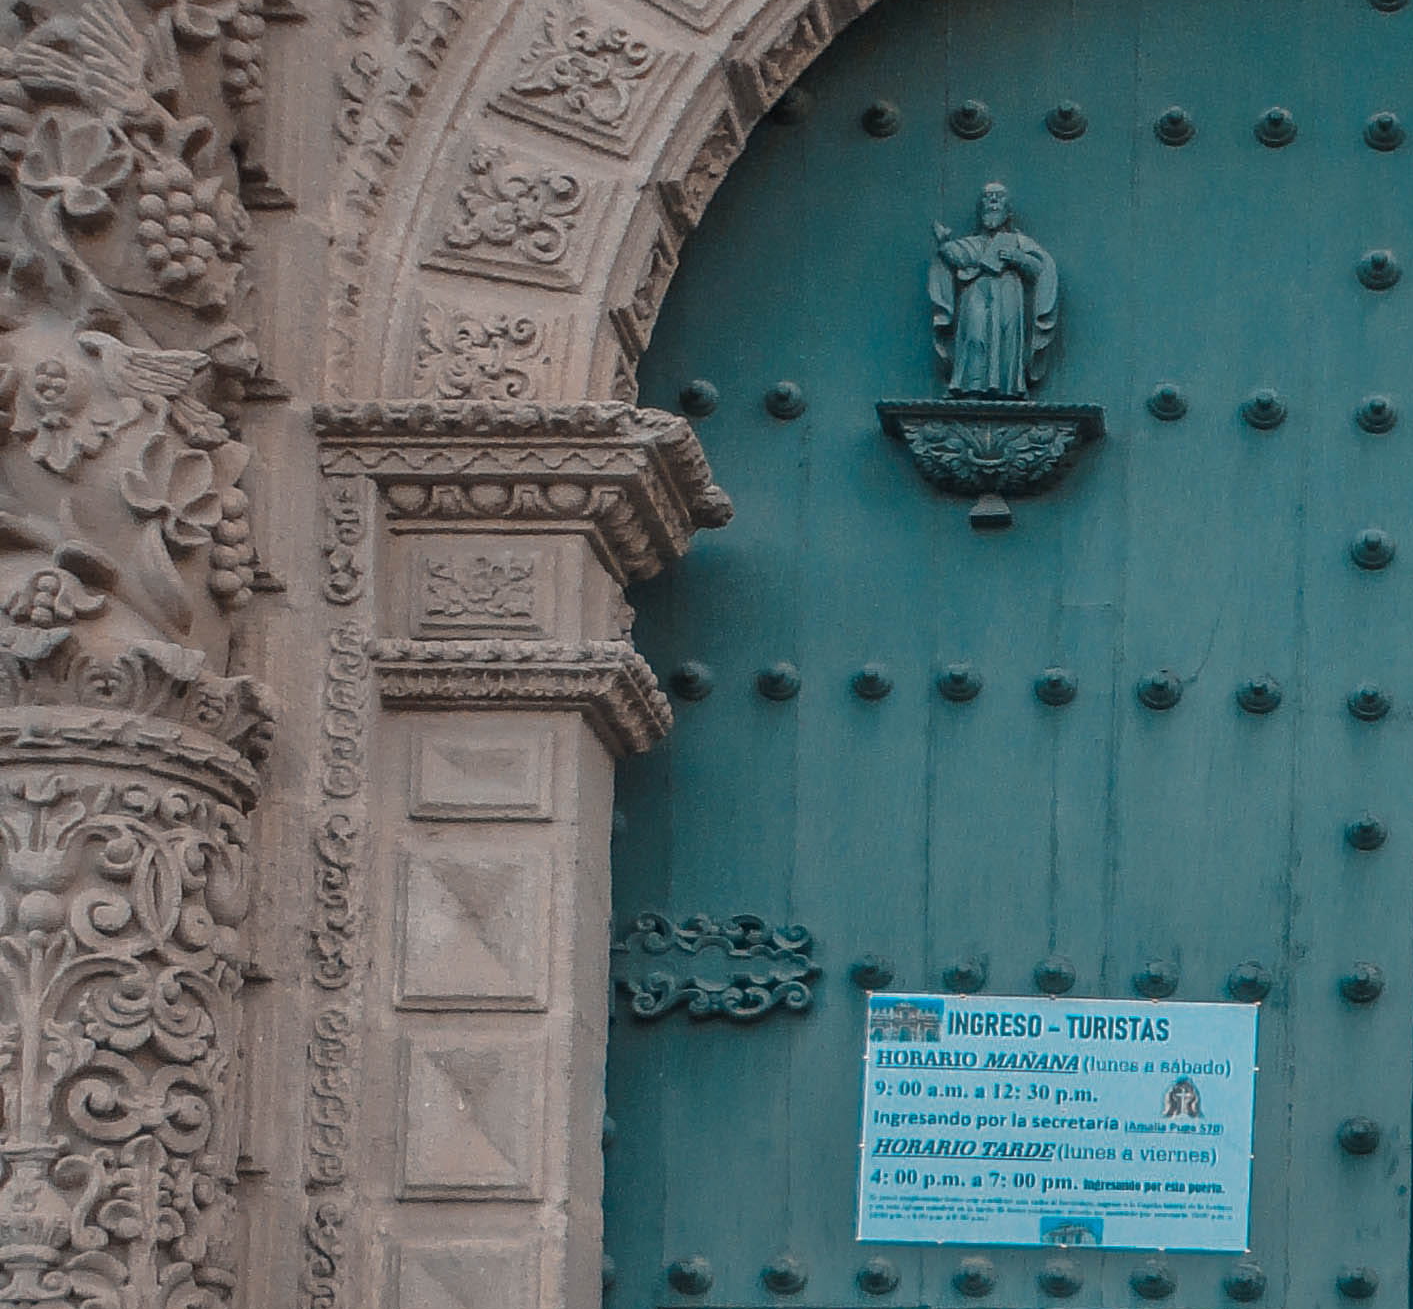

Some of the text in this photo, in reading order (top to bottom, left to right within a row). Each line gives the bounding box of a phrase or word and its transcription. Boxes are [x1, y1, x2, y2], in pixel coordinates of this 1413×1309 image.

[947, 1010, 1042, 1038] INGRESO
[1065, 1013, 1170, 1041] TURISTAS
[876, 1049, 1232, 1078] HORARIO MAÑANA (lunes a sábado)
[874, 1078, 1098, 1105] 9: 00 a.m. a 12: 30 p.m.
[873, 1109, 972, 1127] Ingresando
[975, 1115, 1007, 1130] por
[1011, 1111, 1027, 1128] la
[1031, 1115, 1119, 1131] secretaría
[872, 1138, 1218, 1166] HORARIO TARDE (lunes a viernes)
[870, 1168, 889, 1185] 4:
[894, 1169, 918, 1185] 00
[922, 1173, 965, 1189] p.m.
[971, 1174, 983, 1187] a
[988, 1171, 1007, 1188] 7:
[1012, 1172, 1036, 1188] 00
[1041, 1176, 1078, 1193] pm.
